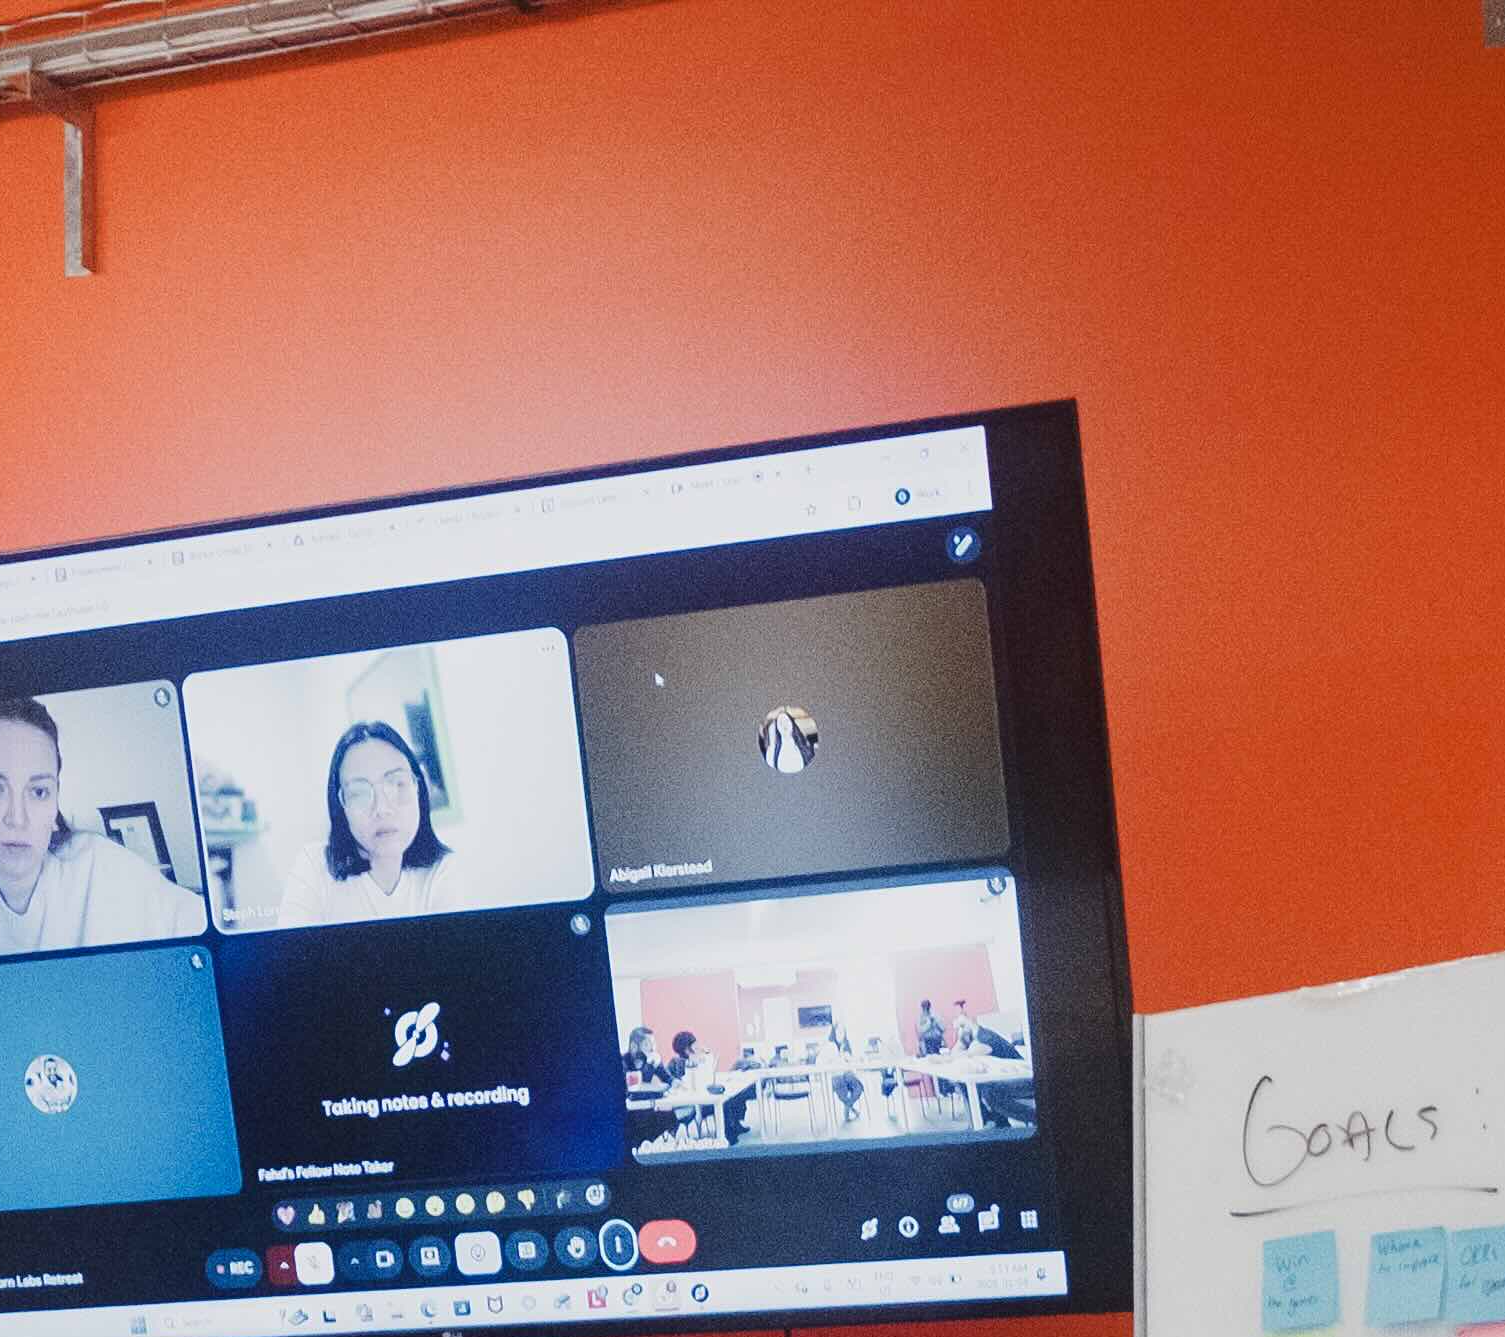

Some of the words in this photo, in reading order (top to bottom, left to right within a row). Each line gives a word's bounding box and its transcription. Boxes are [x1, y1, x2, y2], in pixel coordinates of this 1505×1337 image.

[322, 1098, 379, 1118] Taking
[381, 1093, 429, 1112] notes
[431, 1092, 445, 1108] &
[447, 1085, 531, 1107] recording
[229, 1258, 254, 1276] REC
